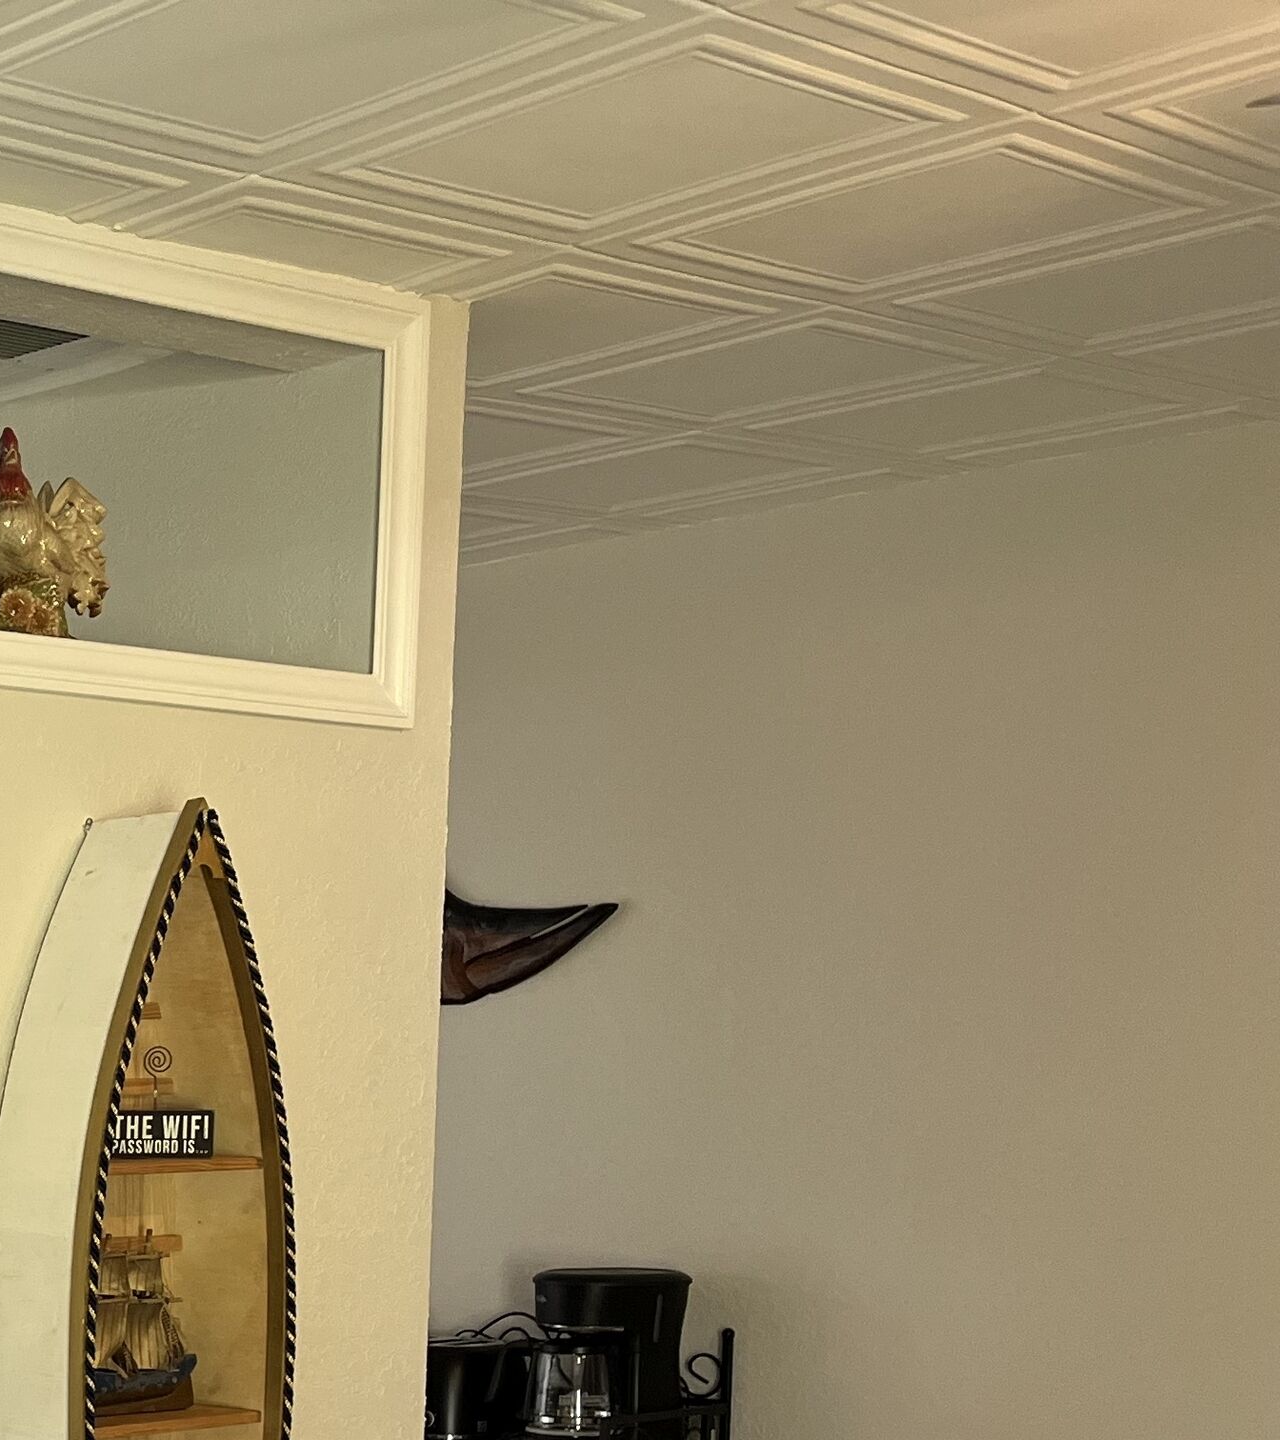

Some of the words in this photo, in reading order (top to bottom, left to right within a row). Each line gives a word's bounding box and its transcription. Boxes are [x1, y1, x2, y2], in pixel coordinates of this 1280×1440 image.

[114, 1114, 153, 1140] THE
[162, 1114, 209, 1140] WIFI
[111, 1139, 179, 1154] PASSWORD
